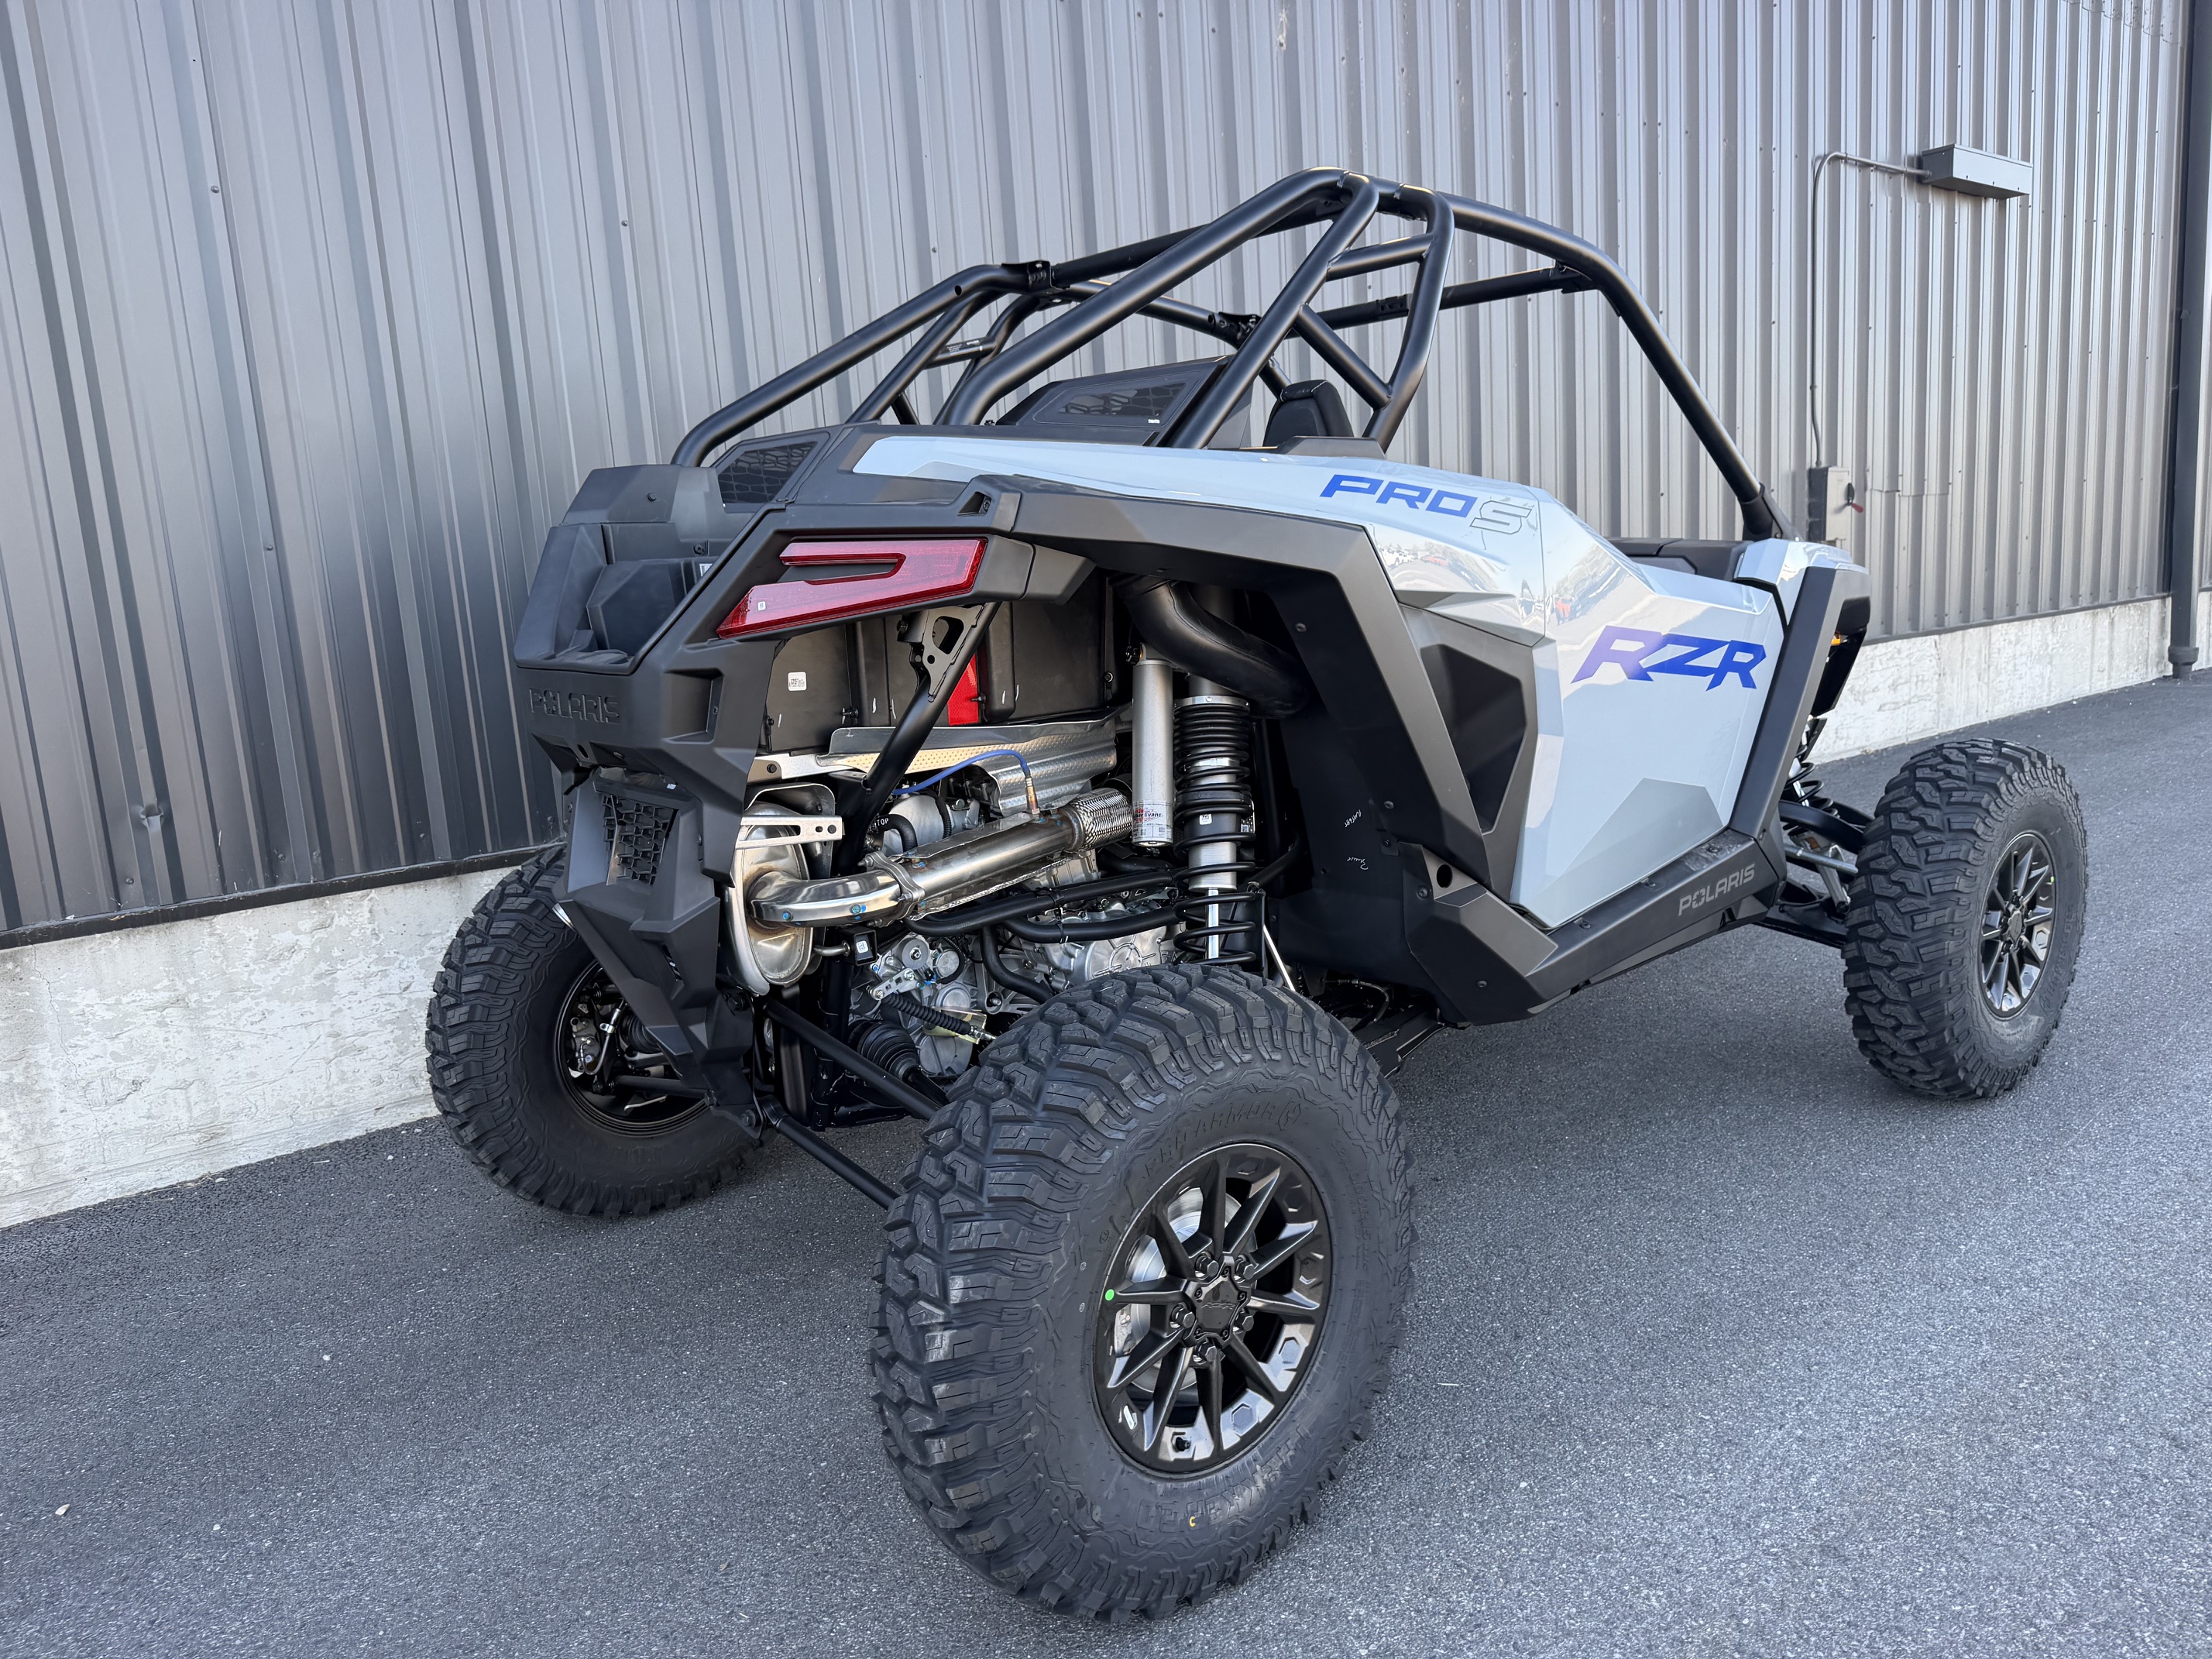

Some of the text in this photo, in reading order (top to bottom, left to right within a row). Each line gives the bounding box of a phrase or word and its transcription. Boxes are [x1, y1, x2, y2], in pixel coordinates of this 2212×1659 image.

[1319, 474, 1533, 535] PRO S
[1571, 624, 1767, 692] RZR
[529, 688, 620, 725] POLARIS
[1678, 863, 1756, 917] POLARIS
